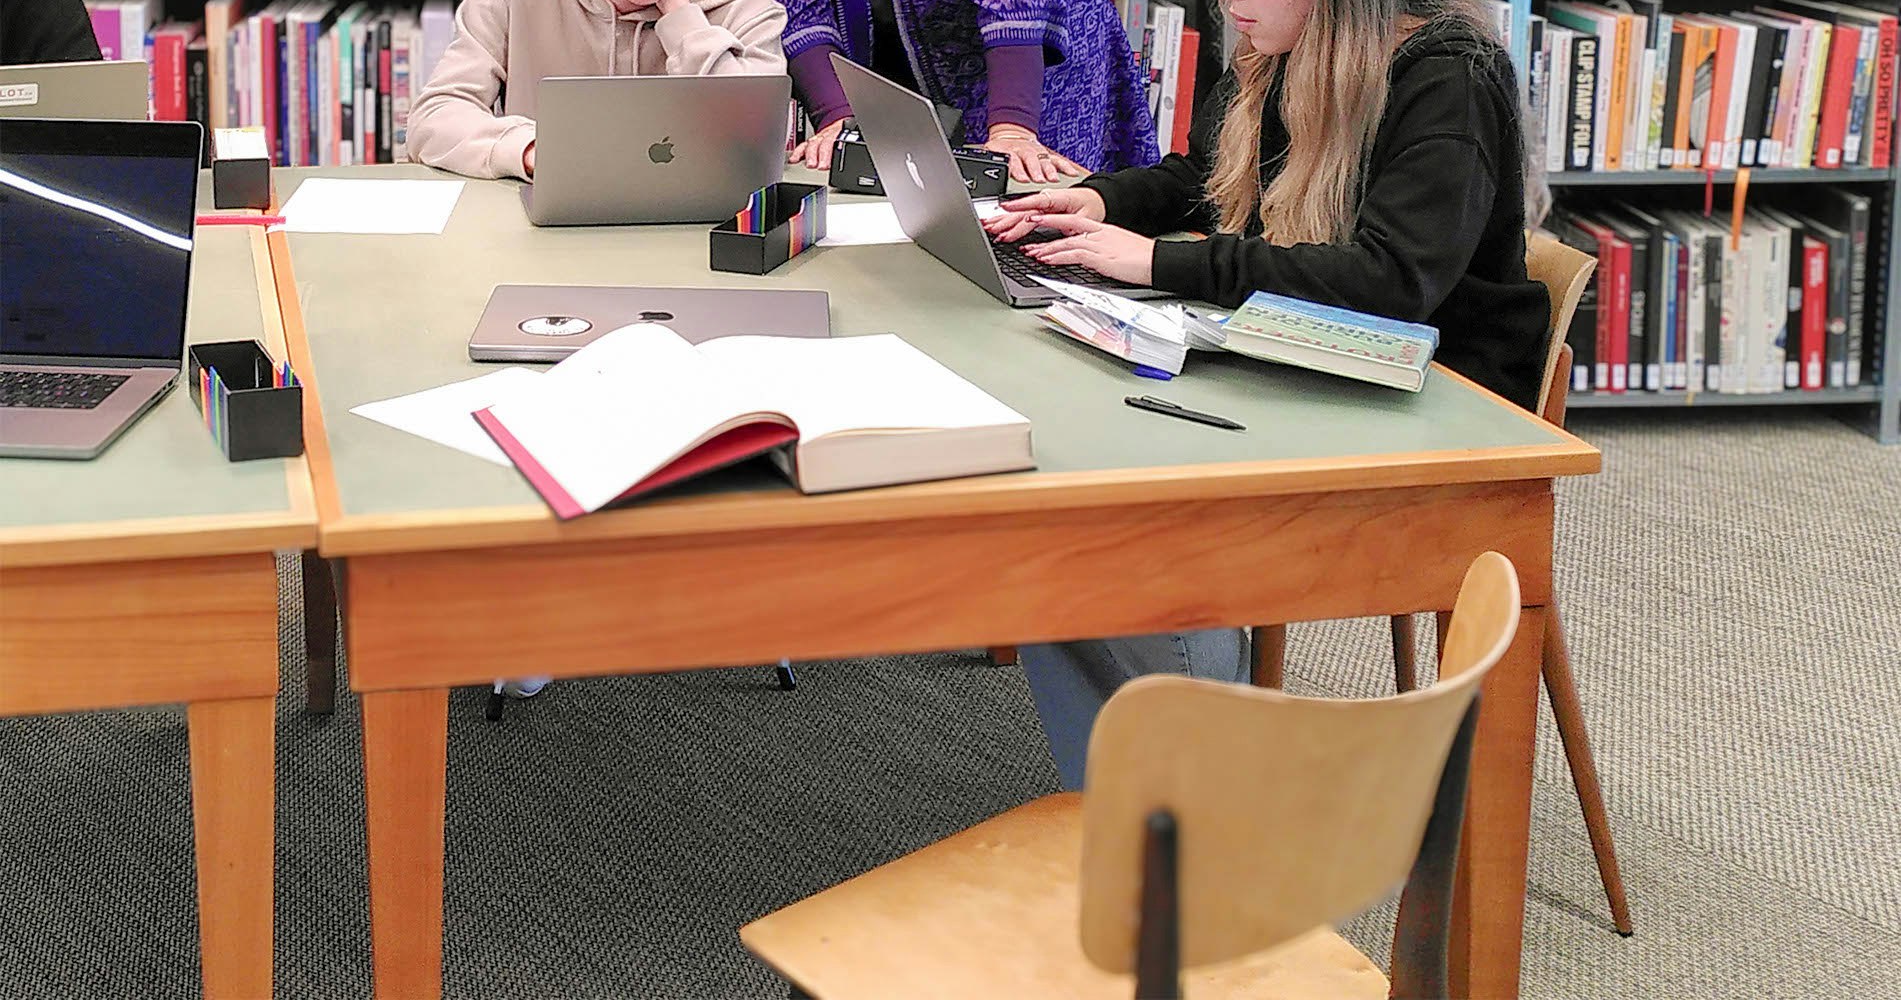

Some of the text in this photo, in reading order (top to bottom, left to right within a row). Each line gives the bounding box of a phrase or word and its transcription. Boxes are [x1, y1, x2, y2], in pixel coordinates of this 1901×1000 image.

[1578, 40, 1596, 70] CLIP
[1575, 73, 1594, 120] STAMP
[1877, 37, 1893, 144] OH SO PRETTY
